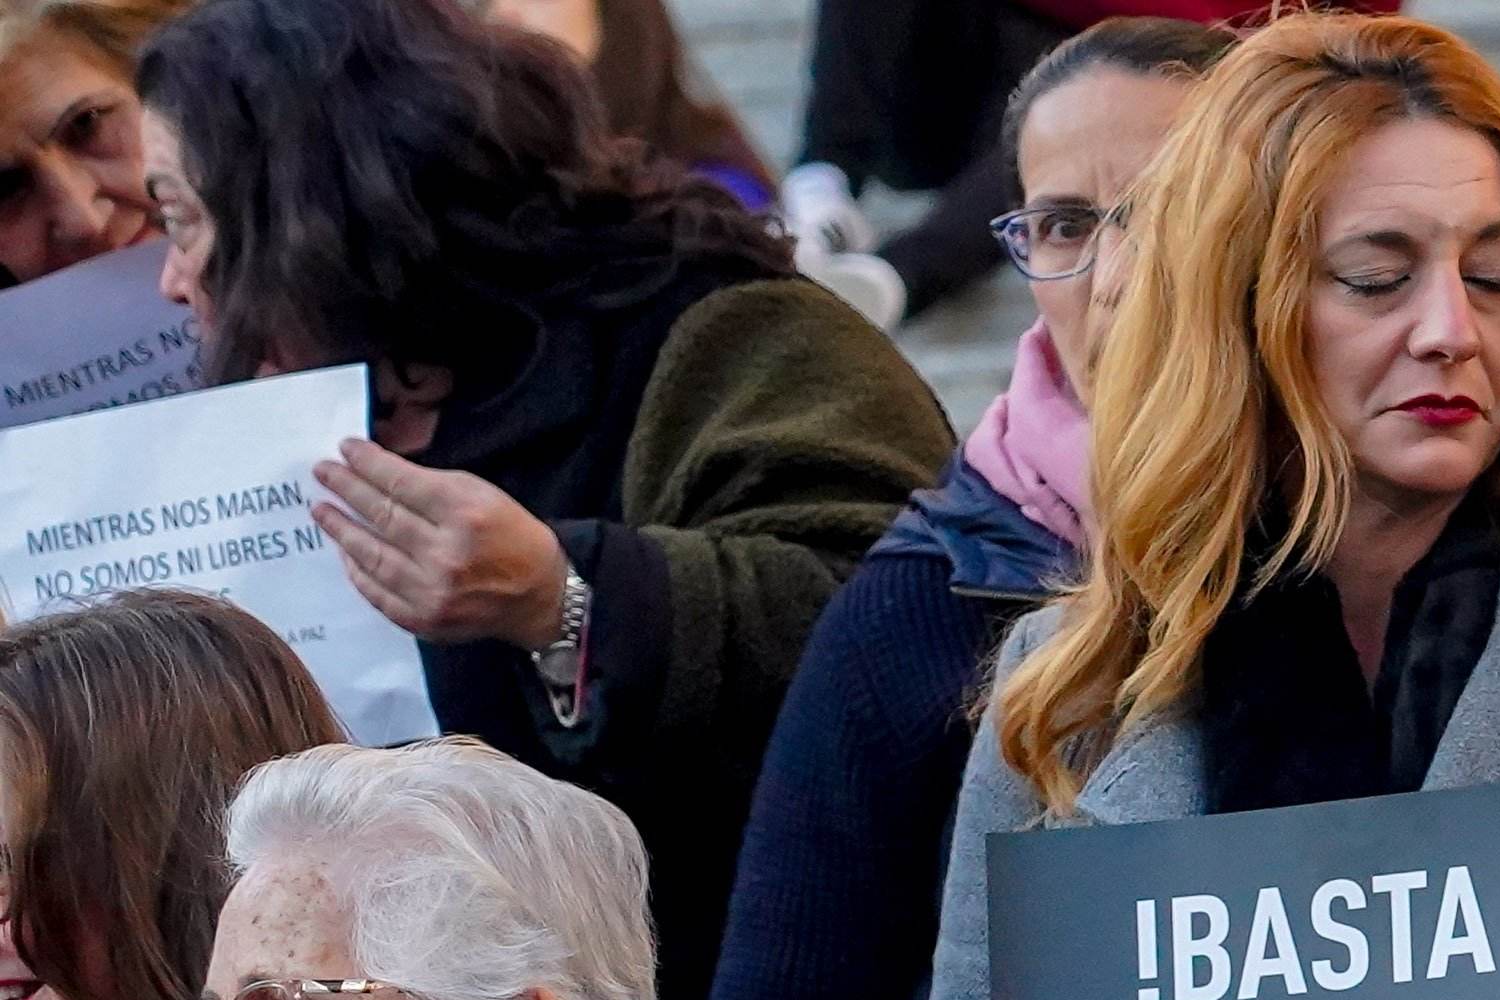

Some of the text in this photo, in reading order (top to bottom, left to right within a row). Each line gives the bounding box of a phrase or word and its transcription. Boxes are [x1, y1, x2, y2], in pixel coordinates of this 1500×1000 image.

[3, 338, 154, 408] MIENTRAS
[26, 506, 156, 556] MIENTRAS
[161, 495, 211, 531] NOS
[34, 522, 325, 601] NO SOMOS NI LIBRES NI
